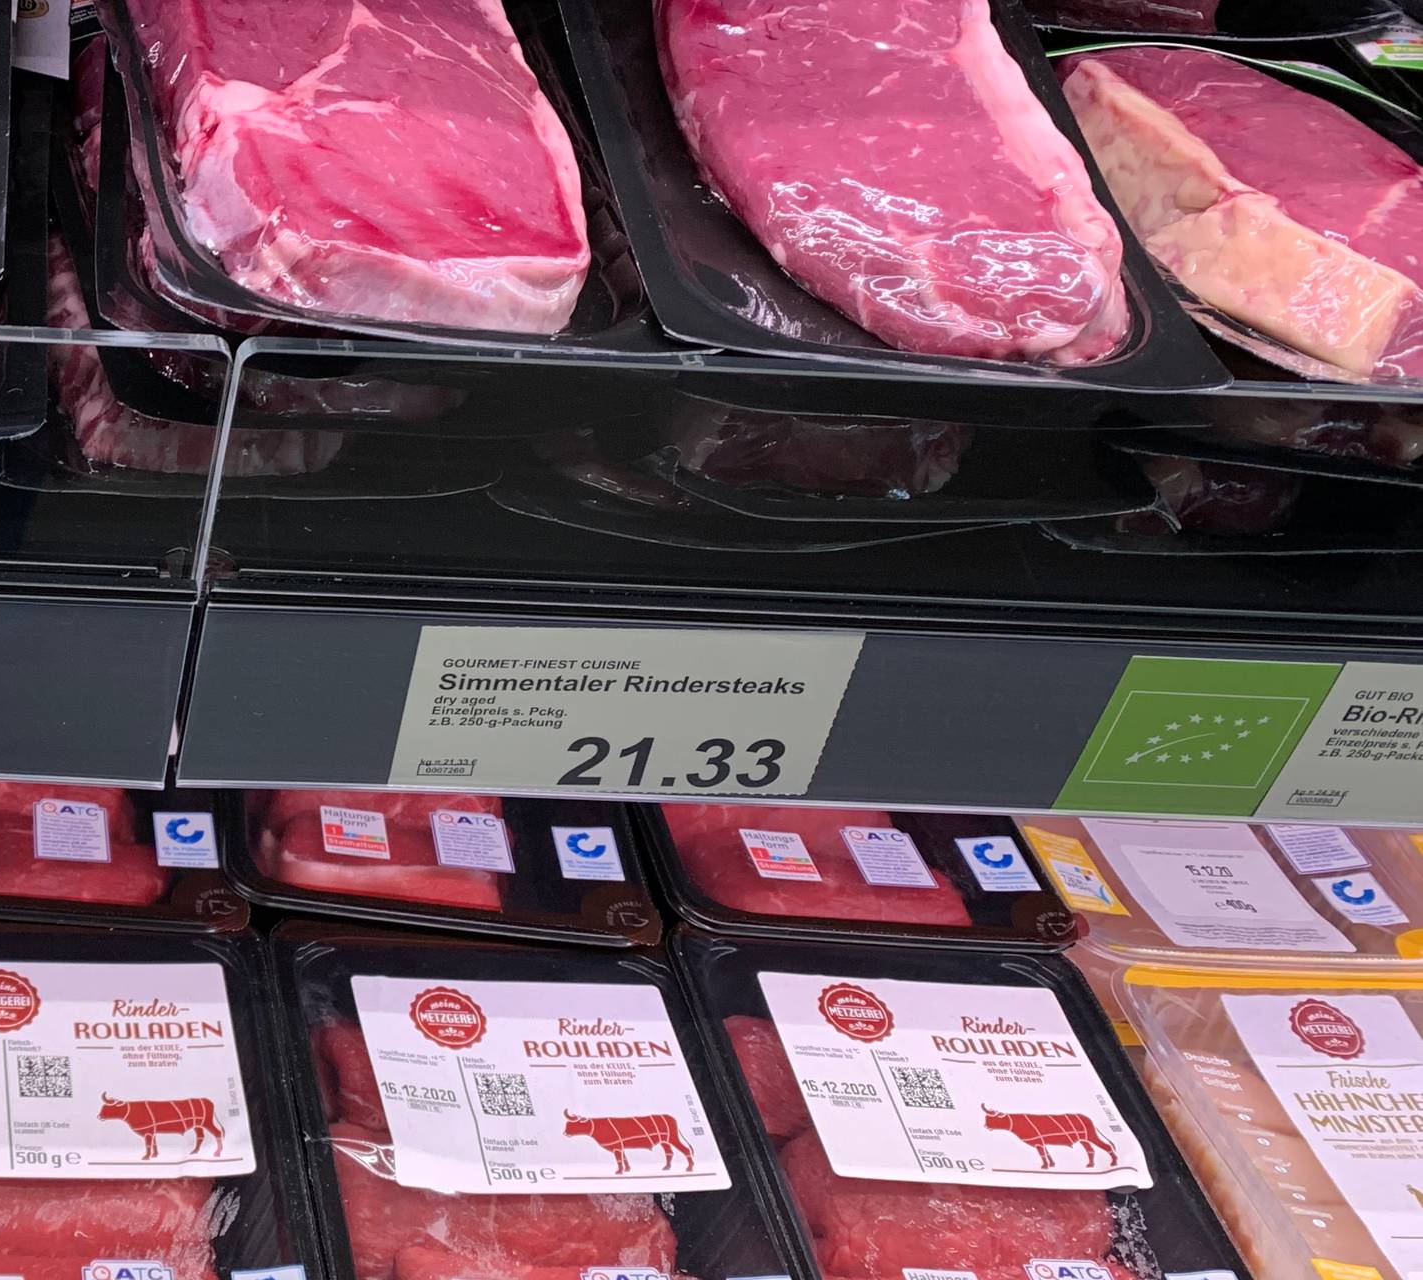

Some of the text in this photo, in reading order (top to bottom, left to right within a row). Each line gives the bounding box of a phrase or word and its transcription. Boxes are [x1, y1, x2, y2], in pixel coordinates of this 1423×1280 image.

[443, 658, 641, 670] GOURMET-FINEST CUISINE
[439, 673, 805, 695] Simmentaler Rindersteaks
[434, 696, 496, 706] dry aged
[1355, 690, 1414, 702] GUT BIO
[432, 706, 568, 719] Einzelpreis s. Pckg.
[428, 717, 562, 729] z.B. 250-g-Packung
[1333, 728, 1420, 739] verschiedene
[1325, 737, 1398, 749] Einzelpreis
[1401, 742, 1411, 750] s.
[1318, 748, 1342, 757] z.B.
[557, 736, 786, 788] 21.33
[324, 809, 377, 822] Haltungs-
[340, 818, 368, 828] form
[744, 831, 798, 844] Haltungs-
[761, 840, 789, 850] form
[112, 998, 190, 1017] Rinder-
[828, 1006, 884, 1019] METZGEREI
[420, 1012, 477, 1024] METZGEREI
[74, 1021, 224, 1040] ROULADEN
[558, 1017, 634, 1036] Rinder-
[961, 1016, 1035, 1035] Rinder-
[523, 1040, 672, 1058] ROULADEN
[932, 1035, 1077, 1058] ROULADEN
[1014, 1076, 1043, 1084] Braten
[1326, 1070, 1391, 1089] Frische
[16, 1151, 61, 1168] 500 g
[922, 1156, 968, 1173] 500 g
[491, 1168, 538, 1183] 500 g
